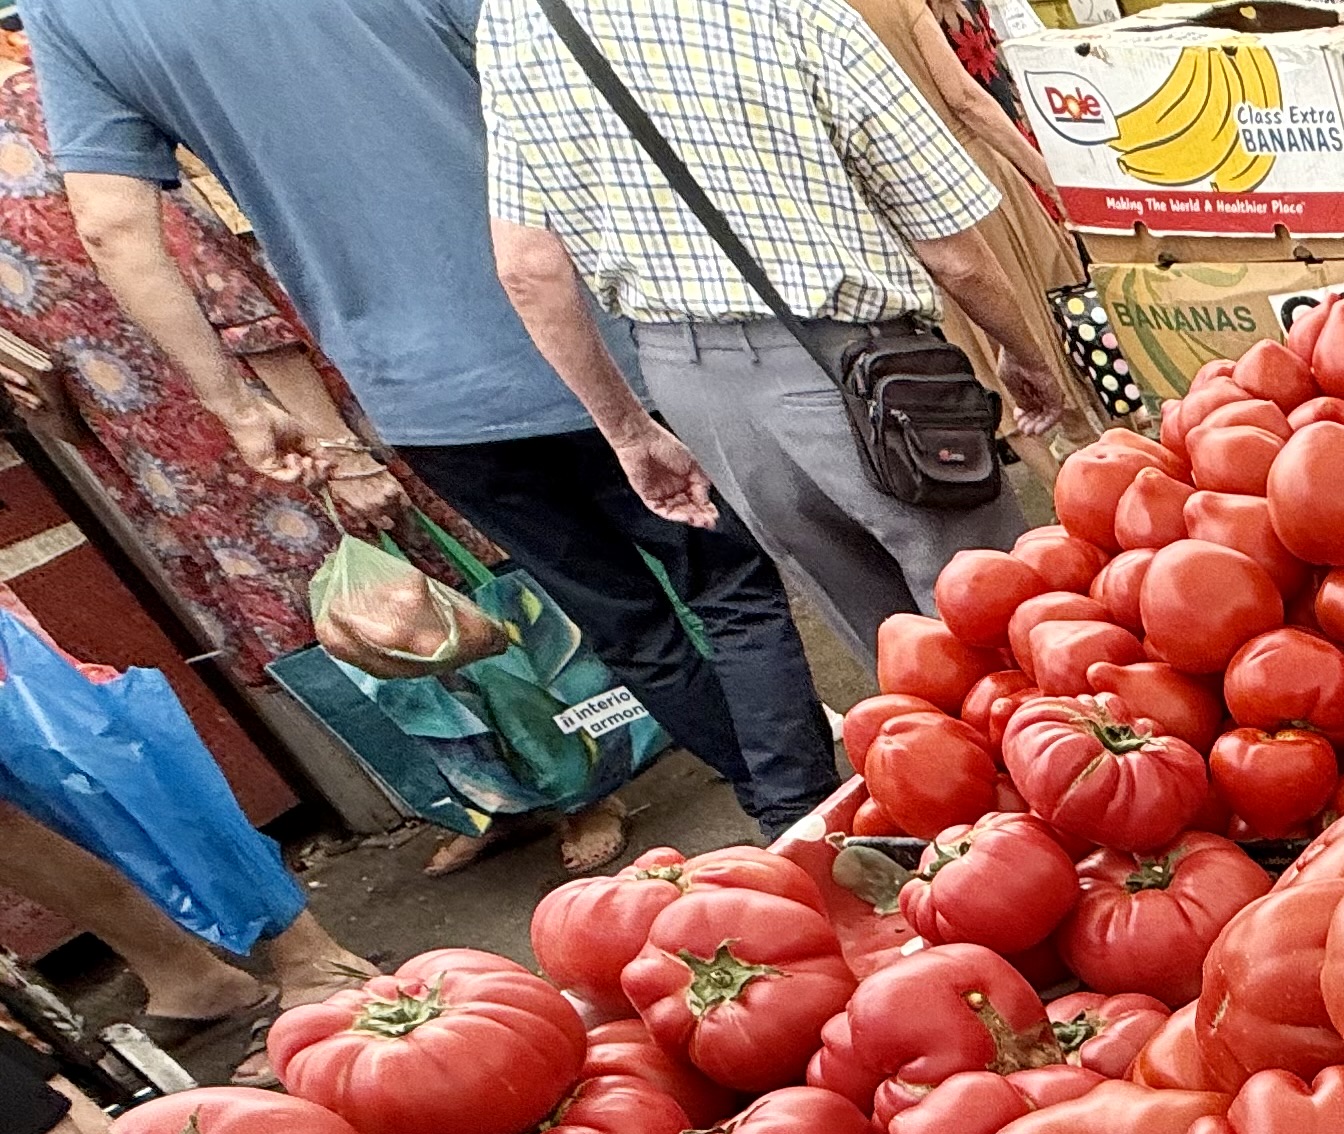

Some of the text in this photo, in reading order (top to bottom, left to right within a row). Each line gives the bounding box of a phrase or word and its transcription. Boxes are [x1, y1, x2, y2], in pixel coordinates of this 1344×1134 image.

[1044, 86, 1101, 121] Dole
[1237, 105, 1335, 124] Class Extra
[1242, 127, 1343, 152] BANANAS
[1106, 196, 1304, 215] Making The World A Healthier Place
[1111, 302, 1257, 333] BANANAS
